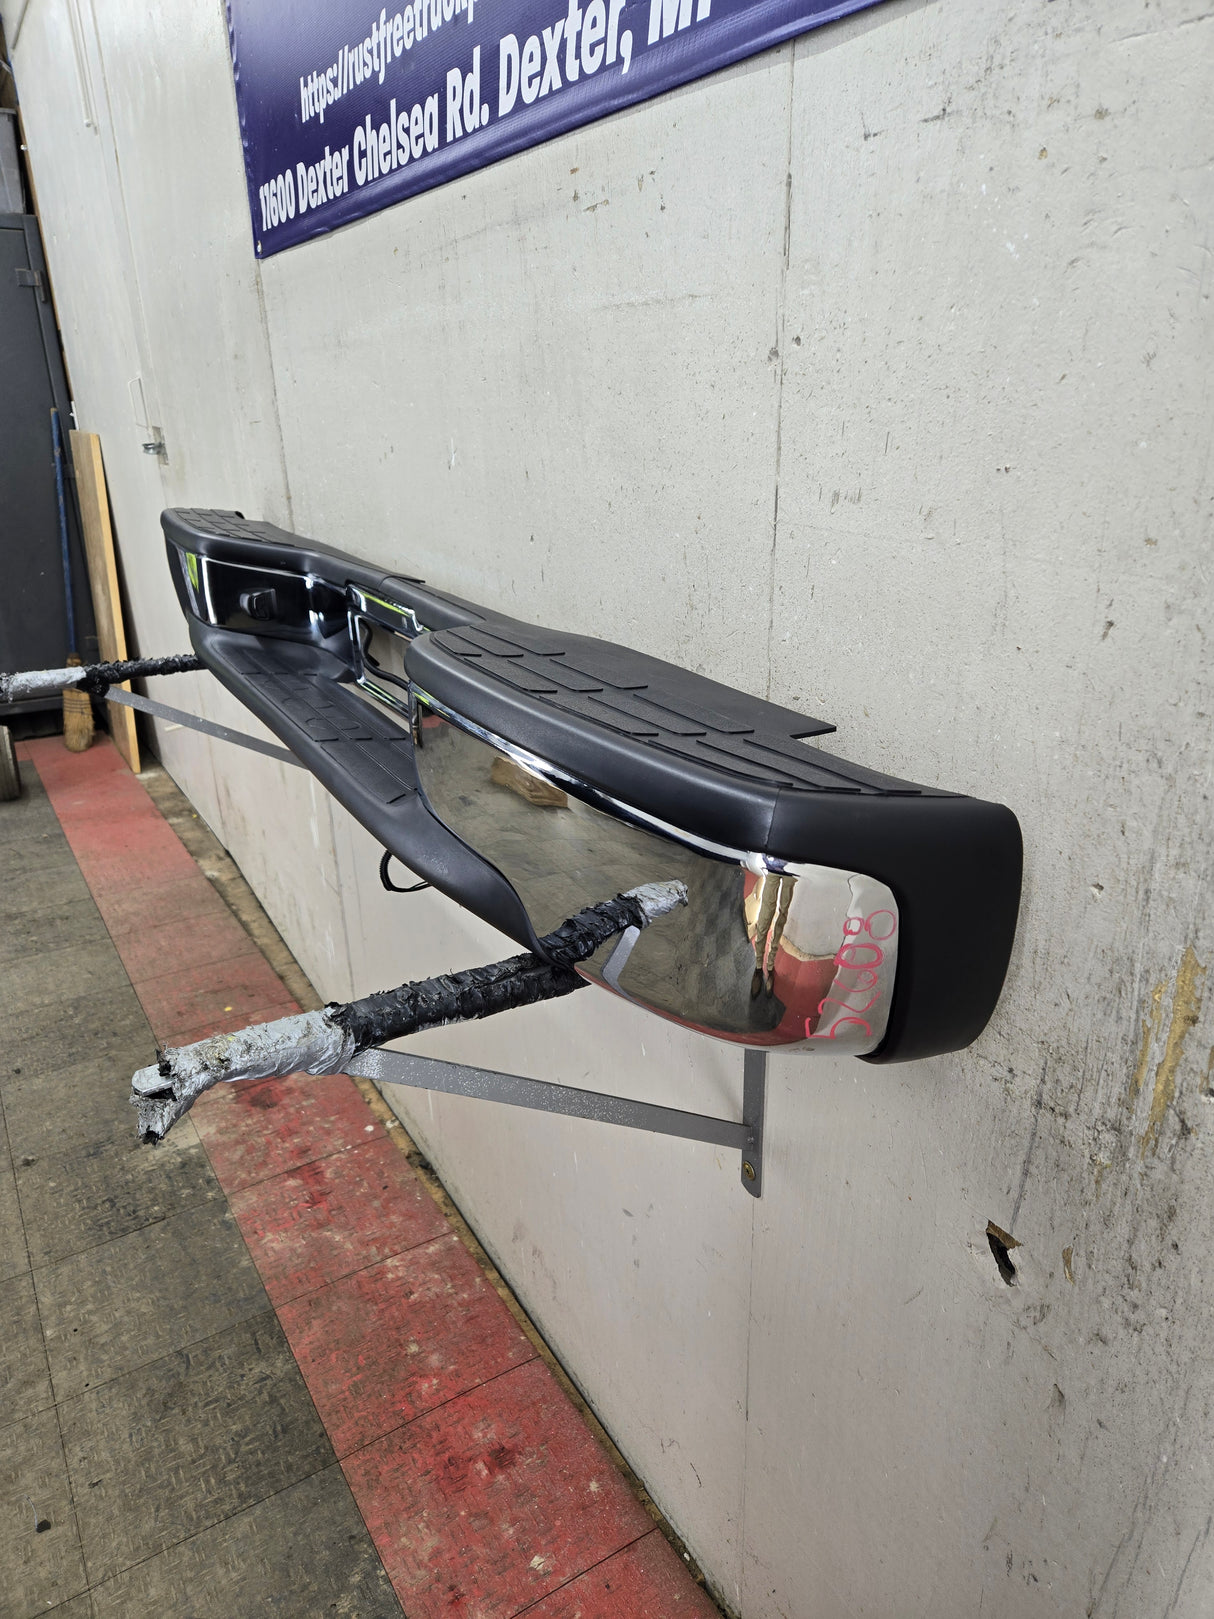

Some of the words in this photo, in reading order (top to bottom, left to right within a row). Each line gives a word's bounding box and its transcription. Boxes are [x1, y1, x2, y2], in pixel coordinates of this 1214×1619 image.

[259, 168, 296, 231] 11600
[296, 144, 349, 214] Dexter
[353, 92, 439, 186] Chelsea
[446, 45, 490, 143] Rd.
[498, 0, 634, 118] Dexter,
[299, 0, 478, 124] https://rustfreetru
